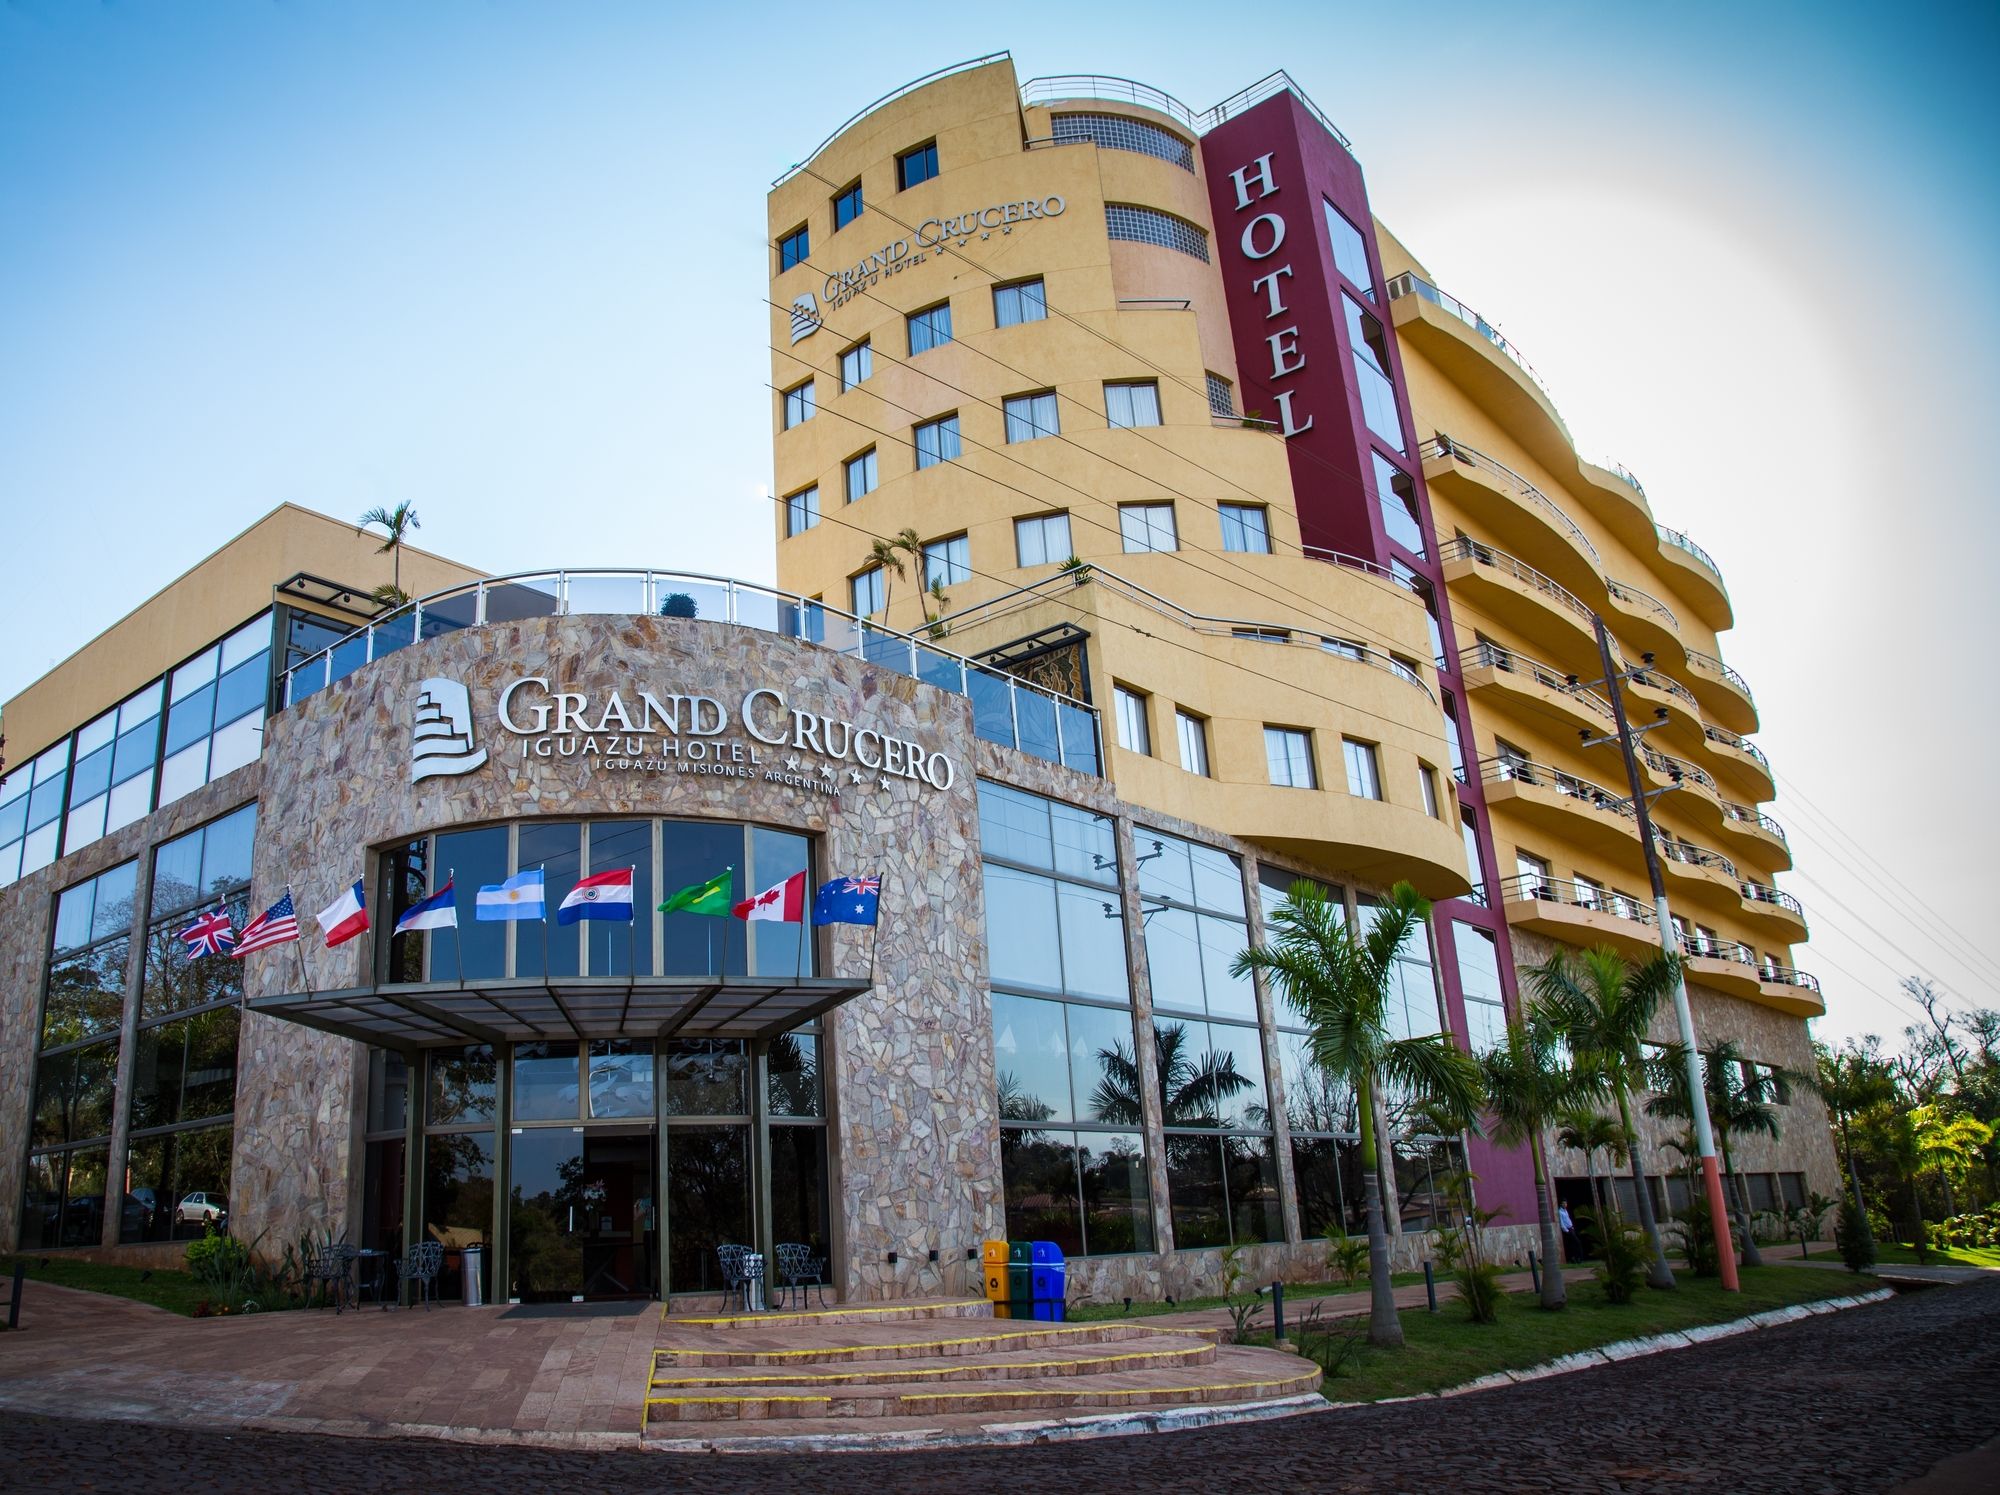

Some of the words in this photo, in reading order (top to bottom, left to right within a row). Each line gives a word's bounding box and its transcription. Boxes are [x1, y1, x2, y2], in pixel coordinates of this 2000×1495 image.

[822, 239, 909, 303] GRAND
[914, 194, 1067, 249] CRUCERO
[833, 275, 878, 311] IGUAZU
[885, 253, 927, 279] HOTEL
[1228, 151, 1313, 438] HOTEL
[498, 677, 728, 737] GRAND
[742, 688, 954, 791] CRUCERO
[523, 736, 643, 758] IGUAZU
[663, 739, 762, 766] HOTEL
[596, 759, 667, 771] IGUAZU
[677, 762, 755, 779] MISIONES
[765, 770, 841, 797] ARGENTINA
